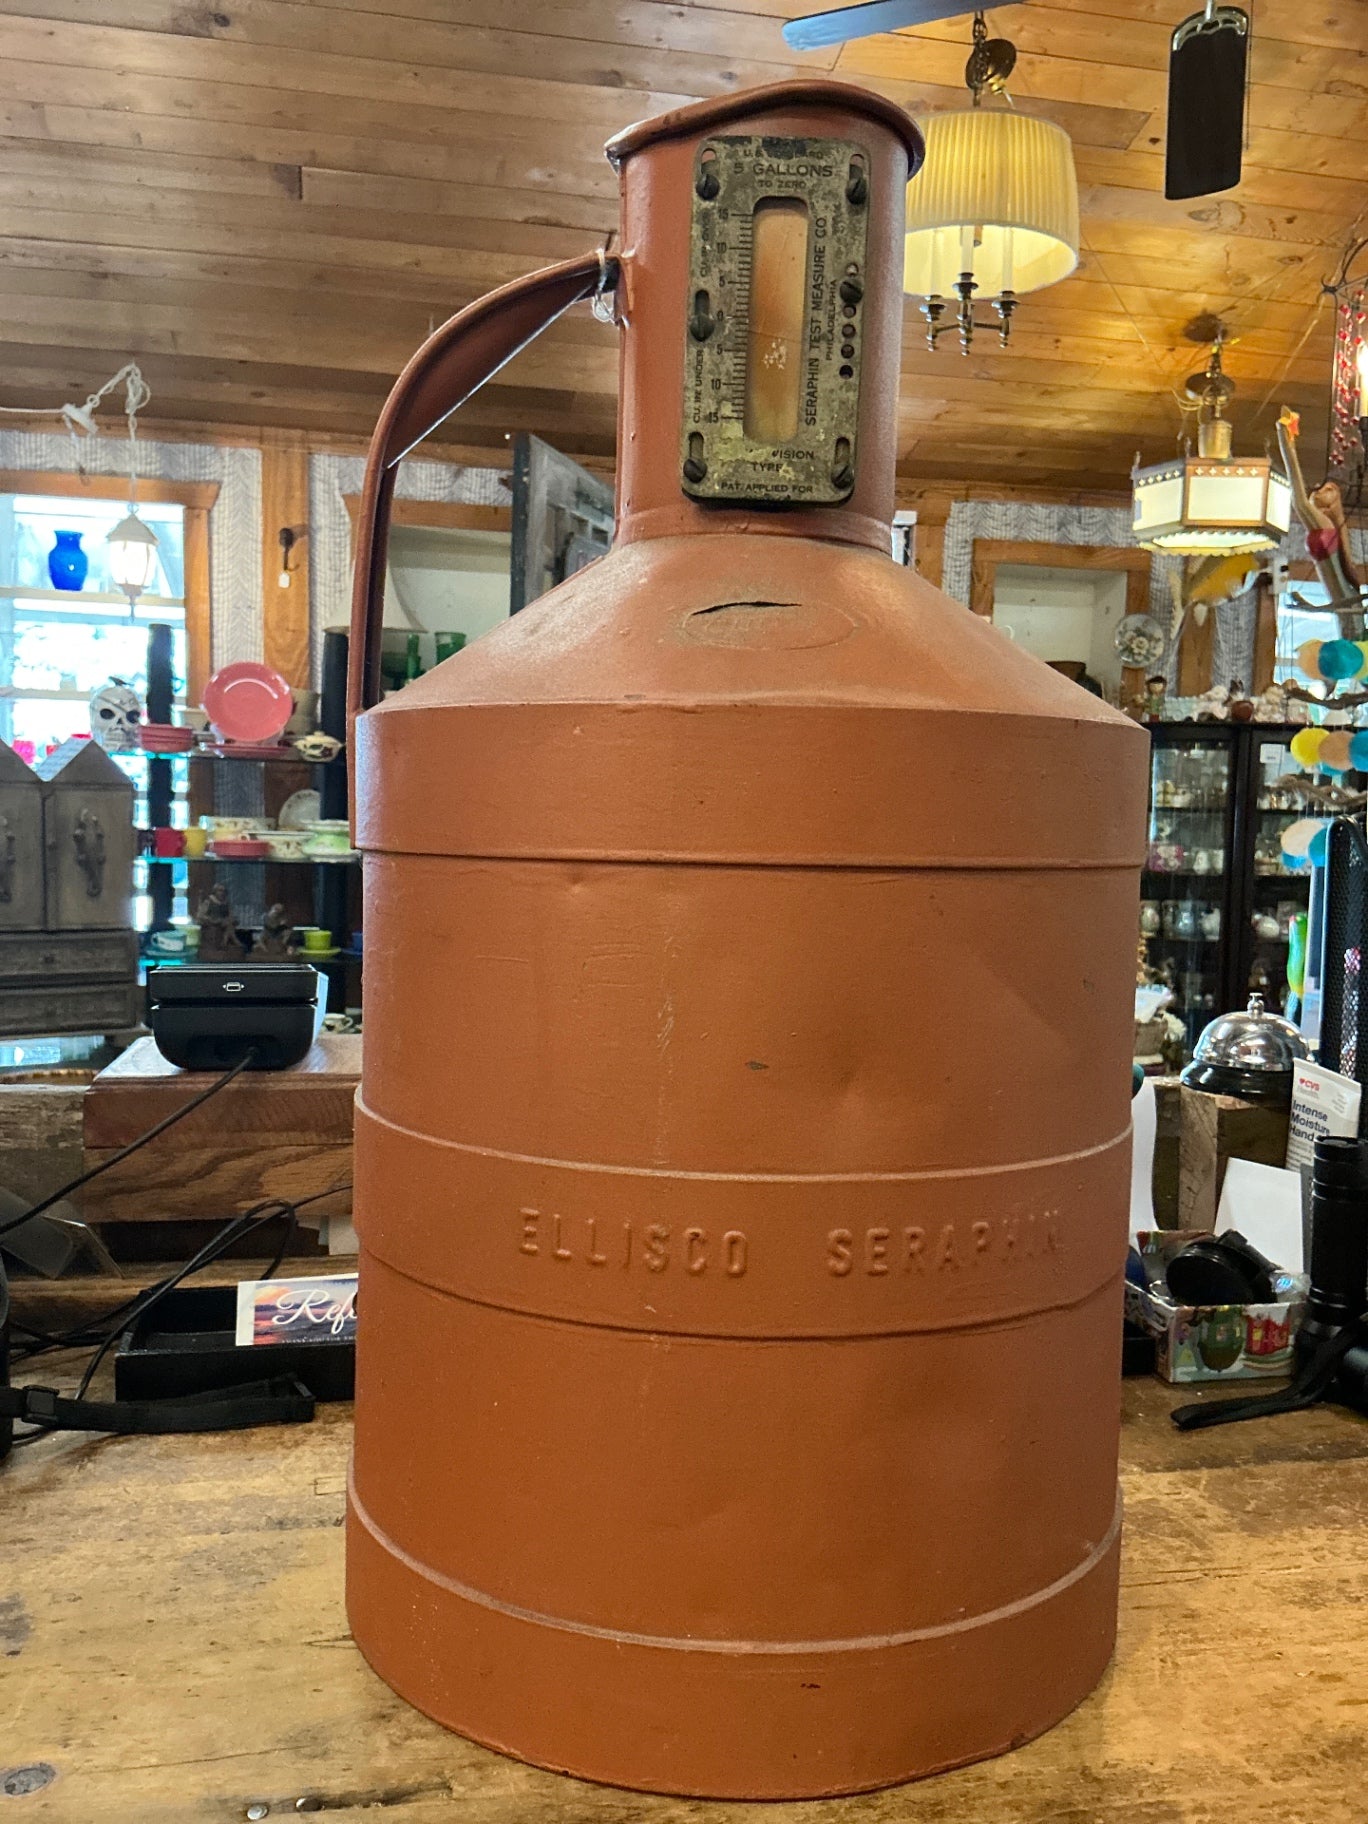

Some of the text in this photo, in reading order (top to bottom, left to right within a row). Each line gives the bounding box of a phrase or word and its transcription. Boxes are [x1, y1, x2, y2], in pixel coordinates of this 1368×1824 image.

[733, 162, 833, 177] 5 GALLONS
[758, 180, 807, 189] TO ZERO
[716, 243, 728, 254] 10
[718, 276, 726, 287] 5
[811, 245, 826, 312] MEASURE
[716, 311, 724, 321] 0
[826, 279, 837, 361] PHILADELPHIA
[809, 318, 823, 352] TEST
[716, 344, 724, 355] 5
[694, 349, 704, 387] UNDER
[711, 379, 722, 390] 10
[805, 358, 820, 426] SERAPHIN
[708, 412, 719, 424] 15
[745, 483, 788, 493] APPLIED
[792, 484, 814, 493] FOR
[1305, 1080, 1320, 1091] CVS
[1293, 1100, 1328, 1122] Intense
[1289, 1123, 1315, 1141] Hand
[518, 1206, 748, 1278] ELLISCO
